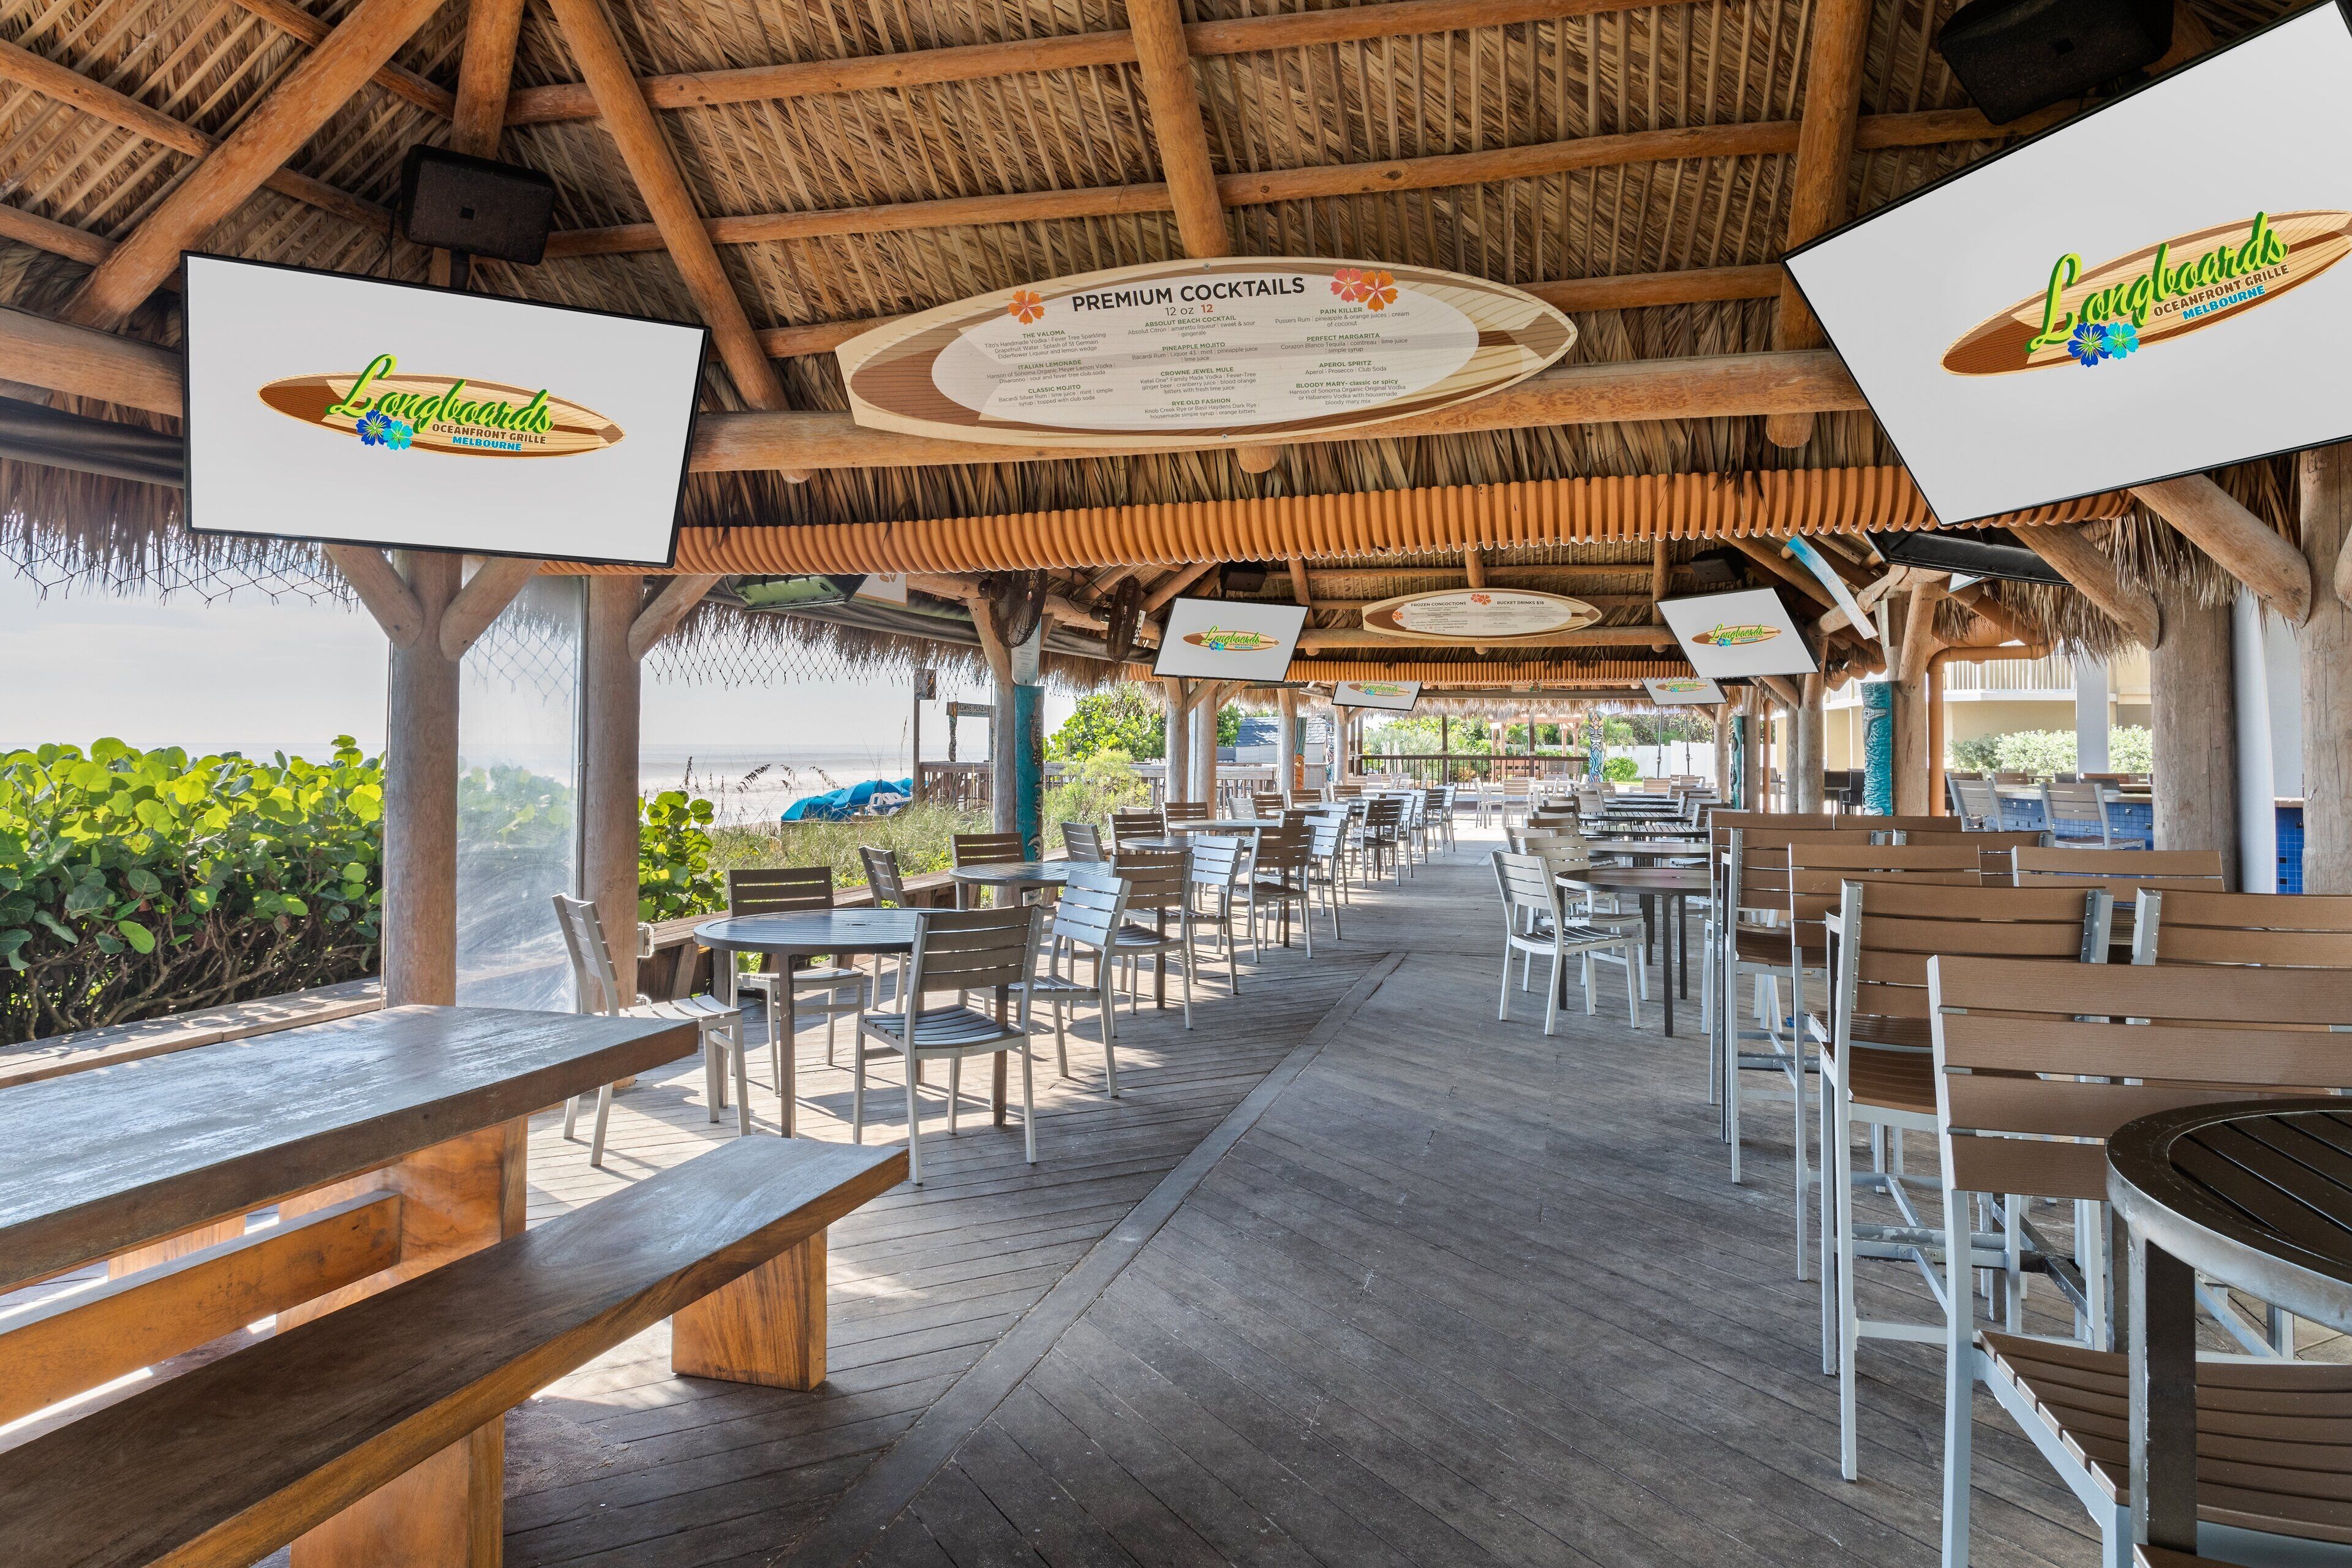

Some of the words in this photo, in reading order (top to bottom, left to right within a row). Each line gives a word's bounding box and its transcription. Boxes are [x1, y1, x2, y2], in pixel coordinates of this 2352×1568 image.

[1072, 287, 1173, 312] PREMIUM
[1180, 277, 1305, 302] COCKTAILS
[2026, 211, 2290, 353] Longboards
[2154, 279, 2242, 317] OCEANFRONT
[2245, 264, 2290, 286] GRILLE
[1166, 307, 1177, 316] 12
[1201, 304, 1213, 313] 12
[2182, 285, 2266, 320] MELBOURNE
[325, 354, 554, 433] Longboards
[432, 423, 507, 440] OCEANFRONT
[509, 432, 547, 445] GRILLE
[453, 435, 522, 451] MELBOURNE
[1202, 625, 1261, 646] Longboards
[1709, 623, 1764, 641] Longboards
